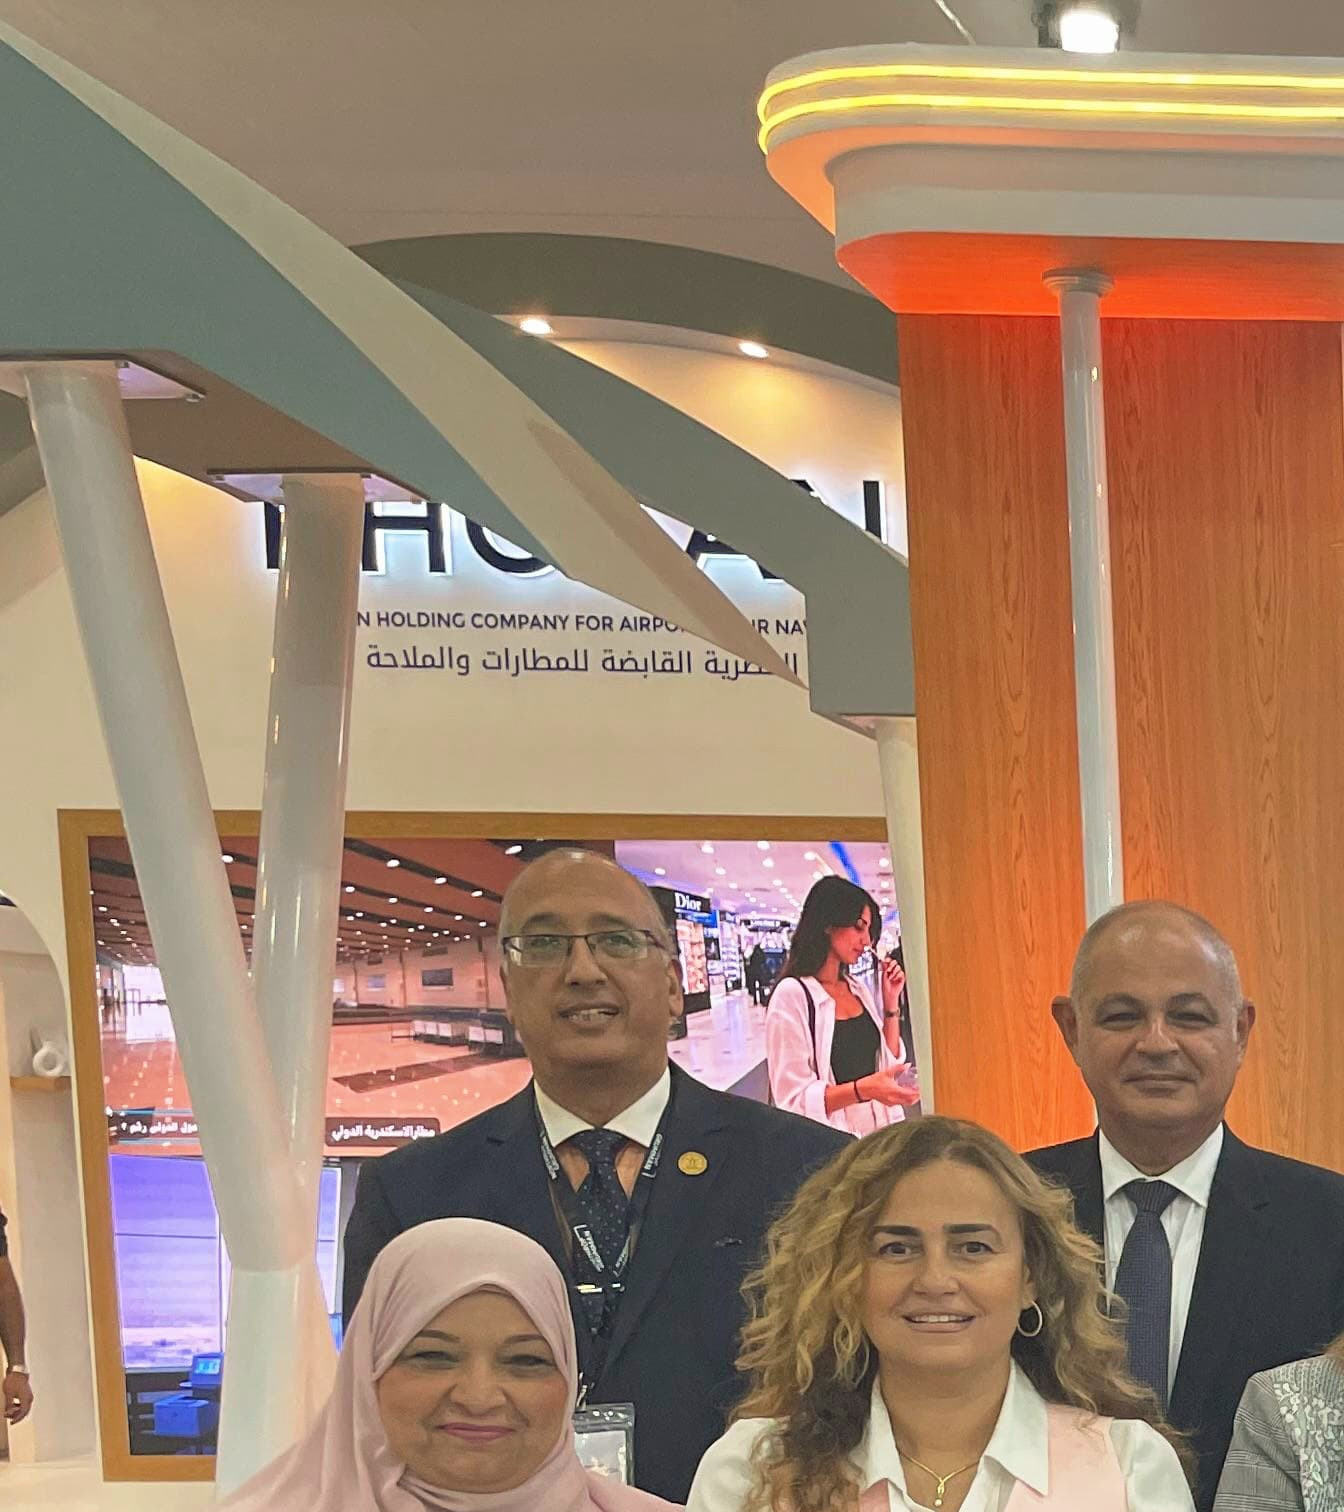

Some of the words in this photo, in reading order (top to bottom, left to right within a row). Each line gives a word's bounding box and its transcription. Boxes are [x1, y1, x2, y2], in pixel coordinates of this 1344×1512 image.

[376, 611, 467, 629] HOLDING
[471, 613, 569, 631] COMPANY
[575, 615, 613, 632] FOR
[366, 644, 471, 677] والملاحة
[481, 647, 589, 678] للمطارات
[601, 648, 693, 680] القابضة
[674, 892, 702, 910] Dior
